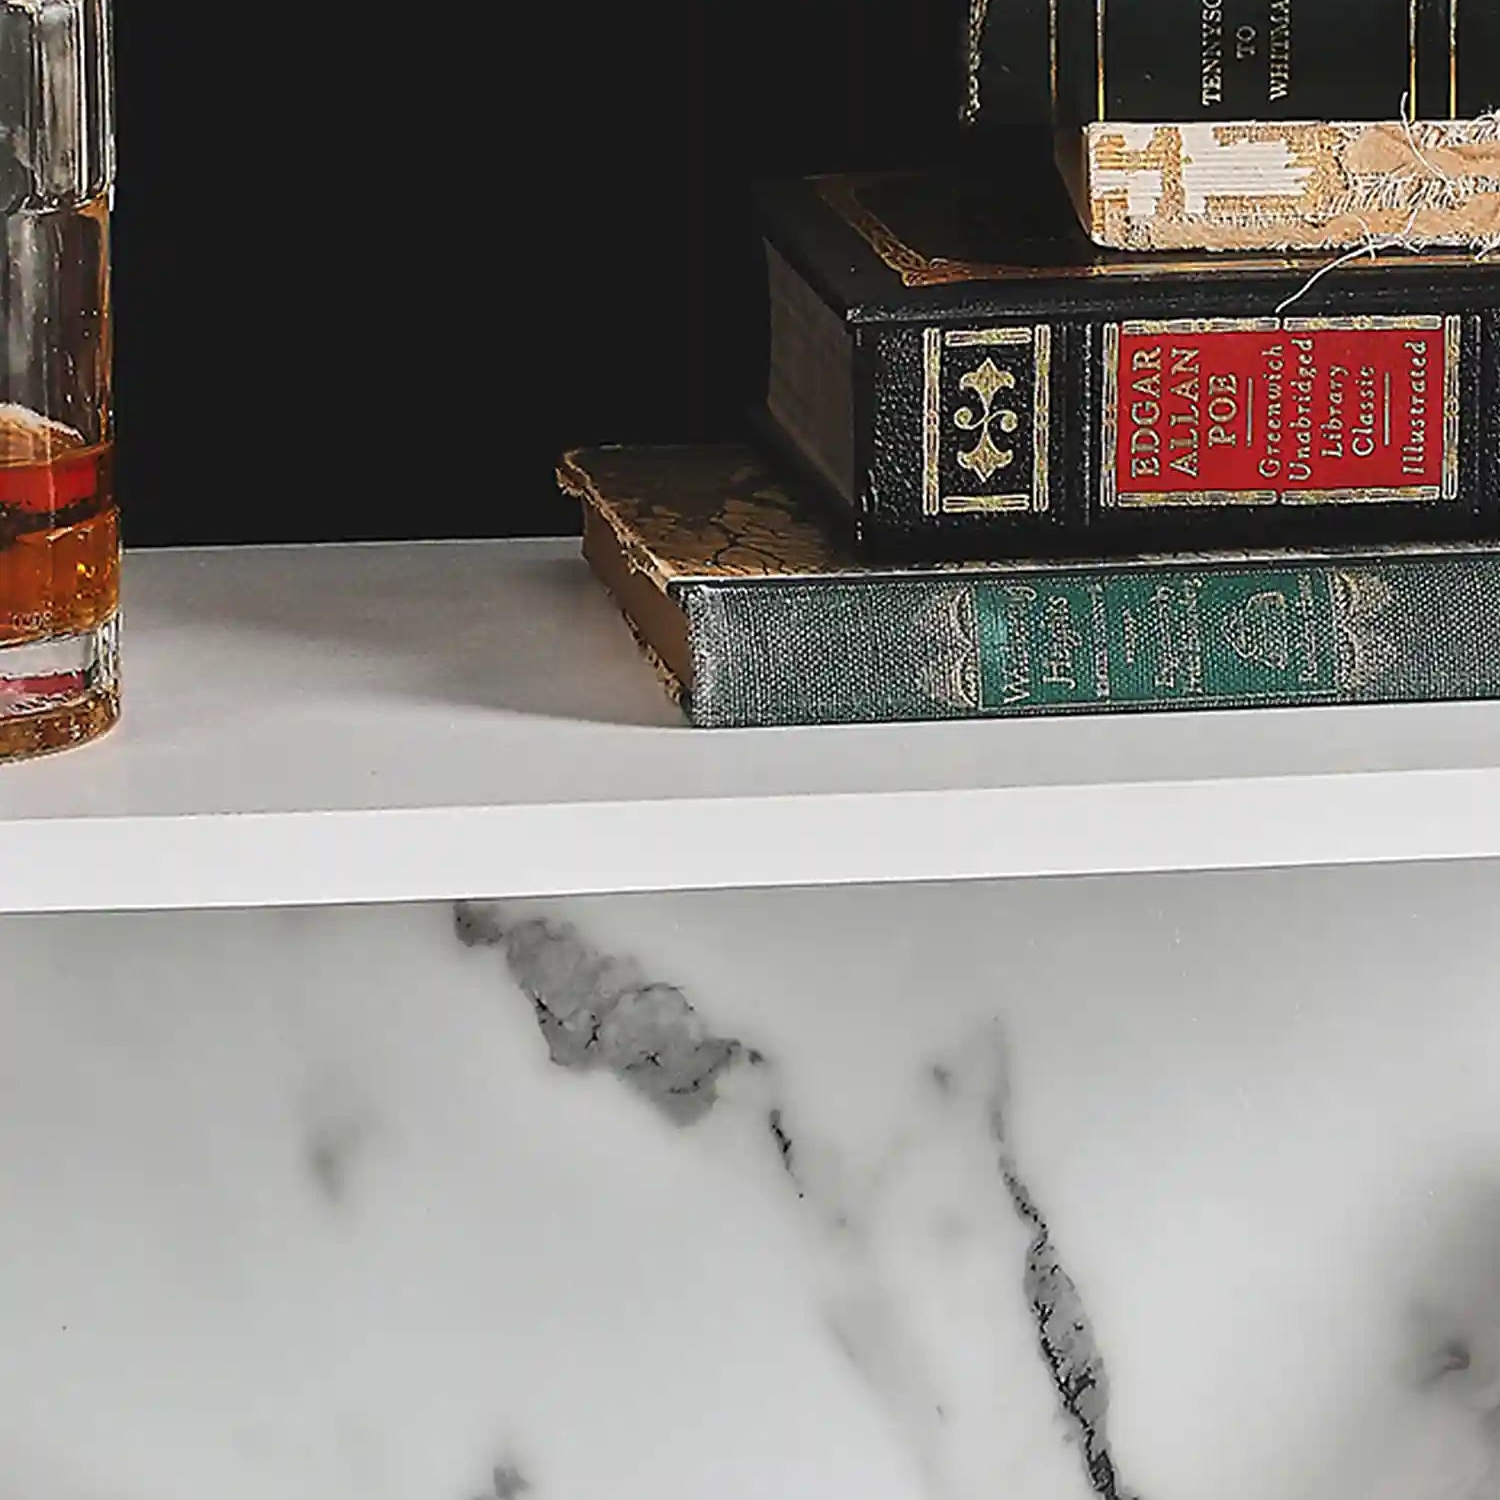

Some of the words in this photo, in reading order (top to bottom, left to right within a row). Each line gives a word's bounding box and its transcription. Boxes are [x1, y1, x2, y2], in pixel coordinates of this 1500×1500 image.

[1236, 24, 1256, 60] TO
[1130, 346, 1161, 479] EDGAR
[1169, 346, 1200, 478] ALLAN
[1207, 372, 1237, 447] POE
[1258, 343, 1284, 478] Greenwich
[1288, 336, 1317, 482] Unabridged
[1321, 365, 1350, 459] Library
[1352, 365, 1376, 457] Classic
[1402, 339, 1428, 476] Illustrated
